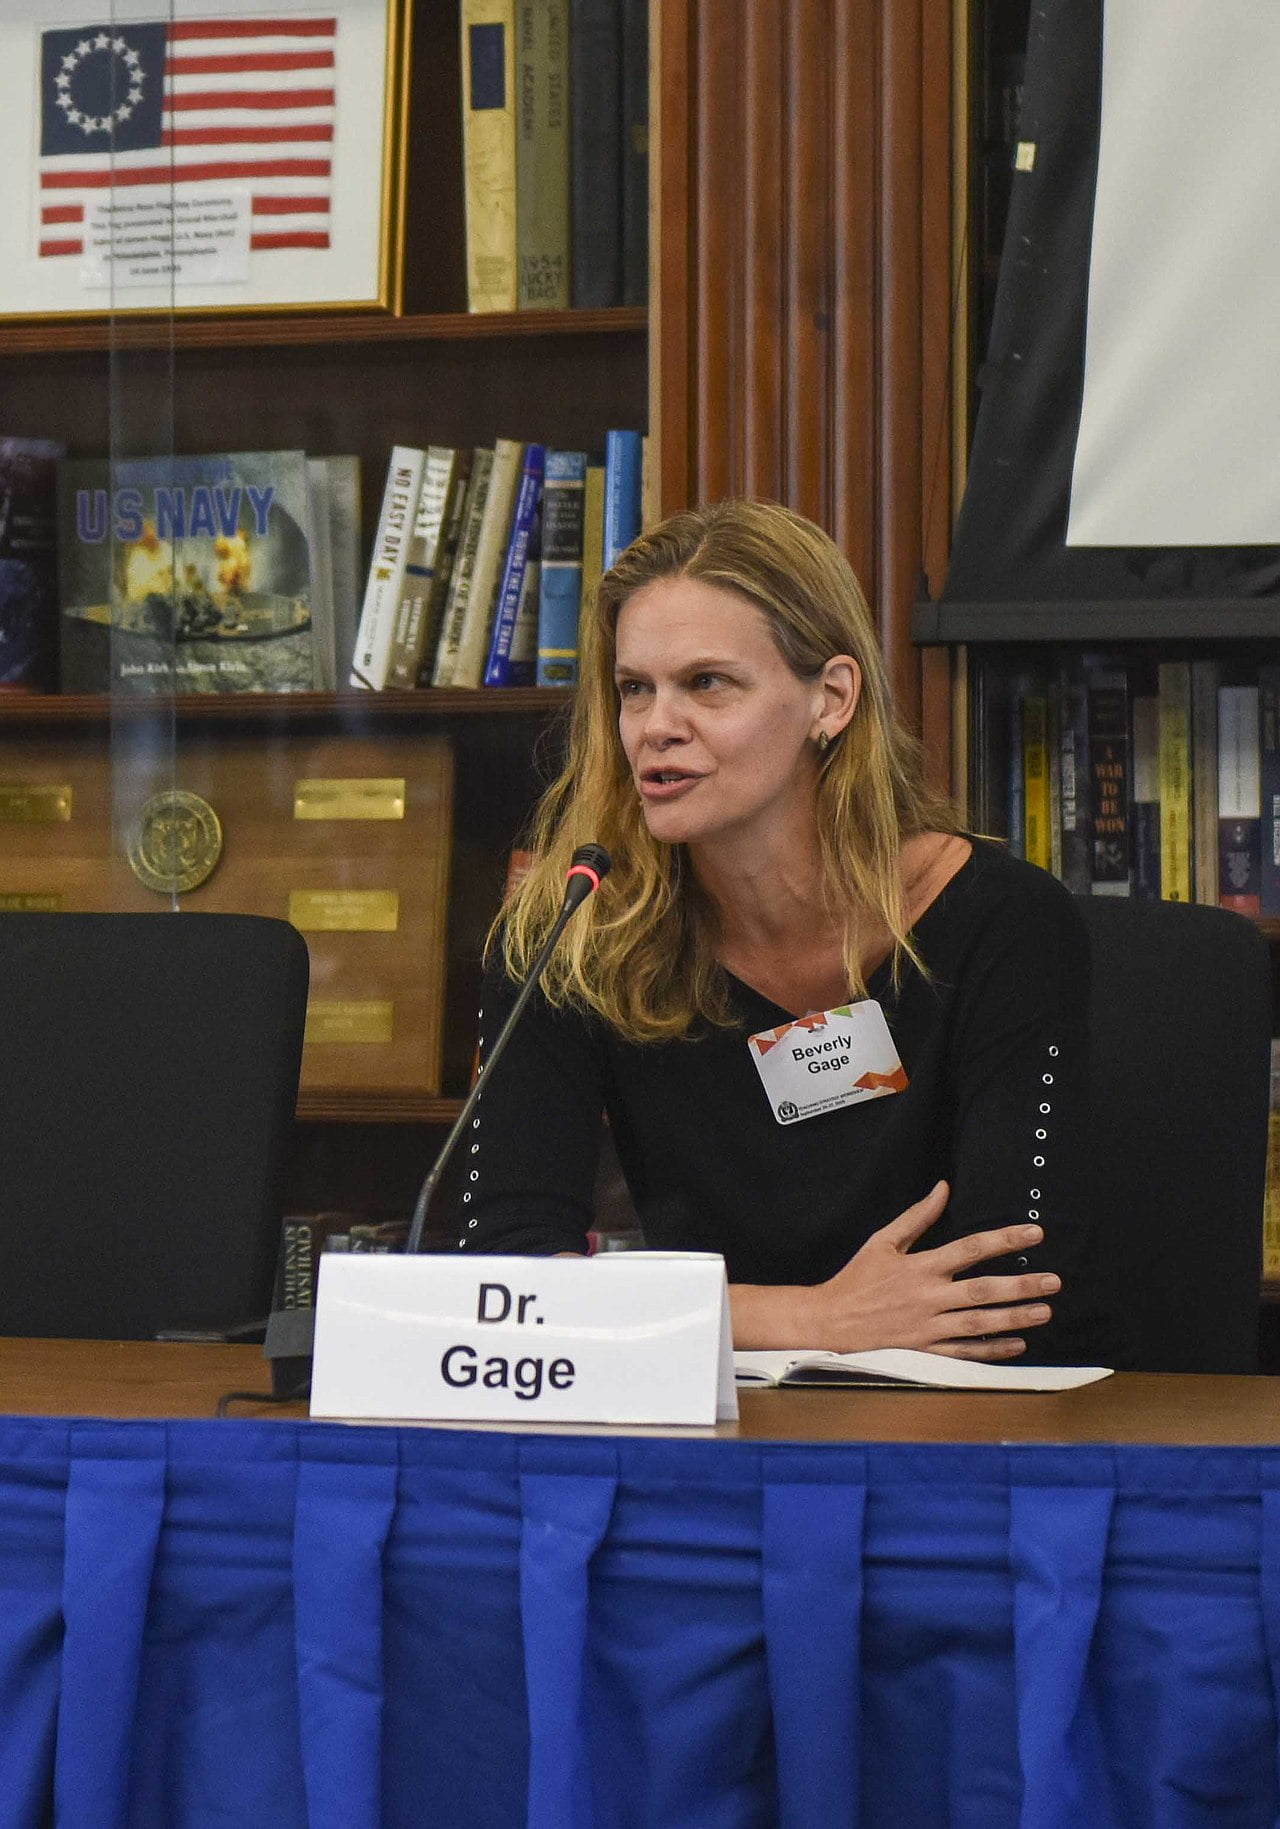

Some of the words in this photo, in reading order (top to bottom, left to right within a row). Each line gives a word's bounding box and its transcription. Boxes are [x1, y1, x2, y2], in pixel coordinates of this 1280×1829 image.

[395, 467, 412, 488] NO
[76, 487, 144, 543] US
[154, 485, 275, 539] NAVY
[388, 492, 409, 531] EASY
[380, 535, 401, 564] DAY
[507, 569, 522, 591] THE
[502, 592, 519, 622] BLUE
[1095, 763, 1124, 779] WAR
[1103, 781, 1119, 797] TO
[1102, 801, 1118, 816] BE
[1094, 818, 1126, 833] WON
[792, 1035, 852, 1062] Beverly
[807, 1055, 851, 1075] Gage
[477, 1282, 545, 1325] Dr.
[441, 1344, 576, 1402] Gage
